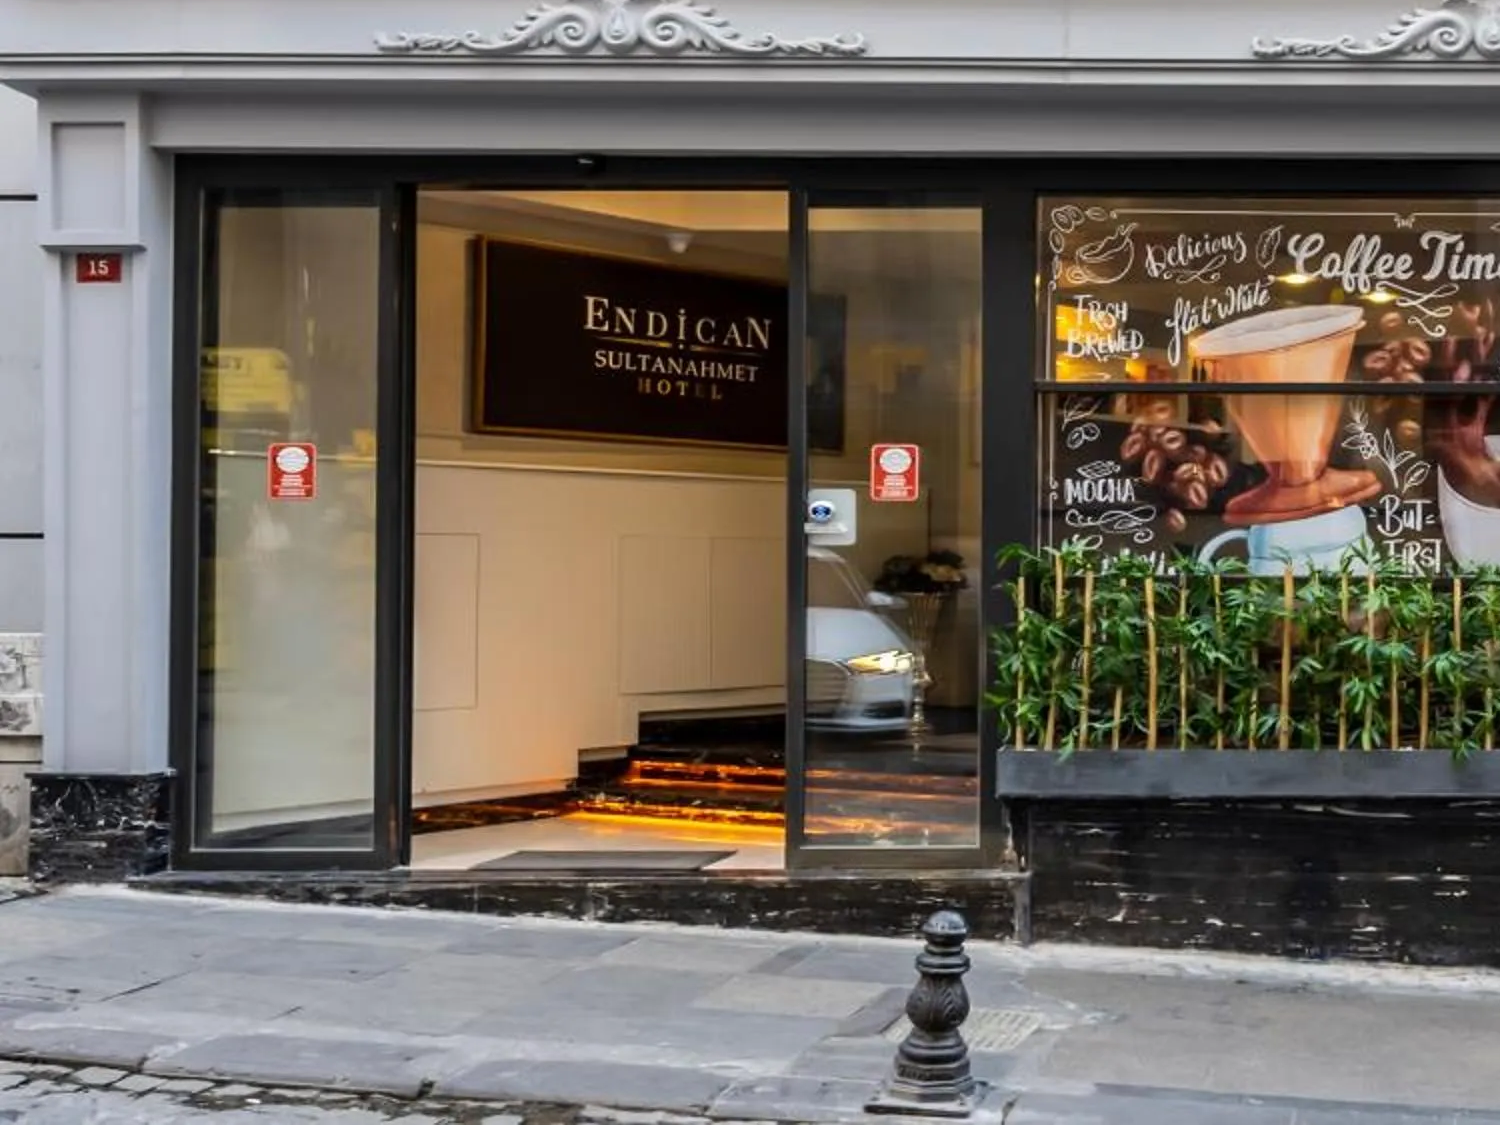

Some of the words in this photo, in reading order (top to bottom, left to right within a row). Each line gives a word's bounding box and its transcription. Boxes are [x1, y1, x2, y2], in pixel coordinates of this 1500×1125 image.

[89, 260, 109, 275] 15
[1145, 232, 1247, 278] Delicious
[1287, 232, 1415, 293] Coffee
[594, 349, 759, 382] SULTANAHMET
[1064, 478, 1135, 505] MOCHA
